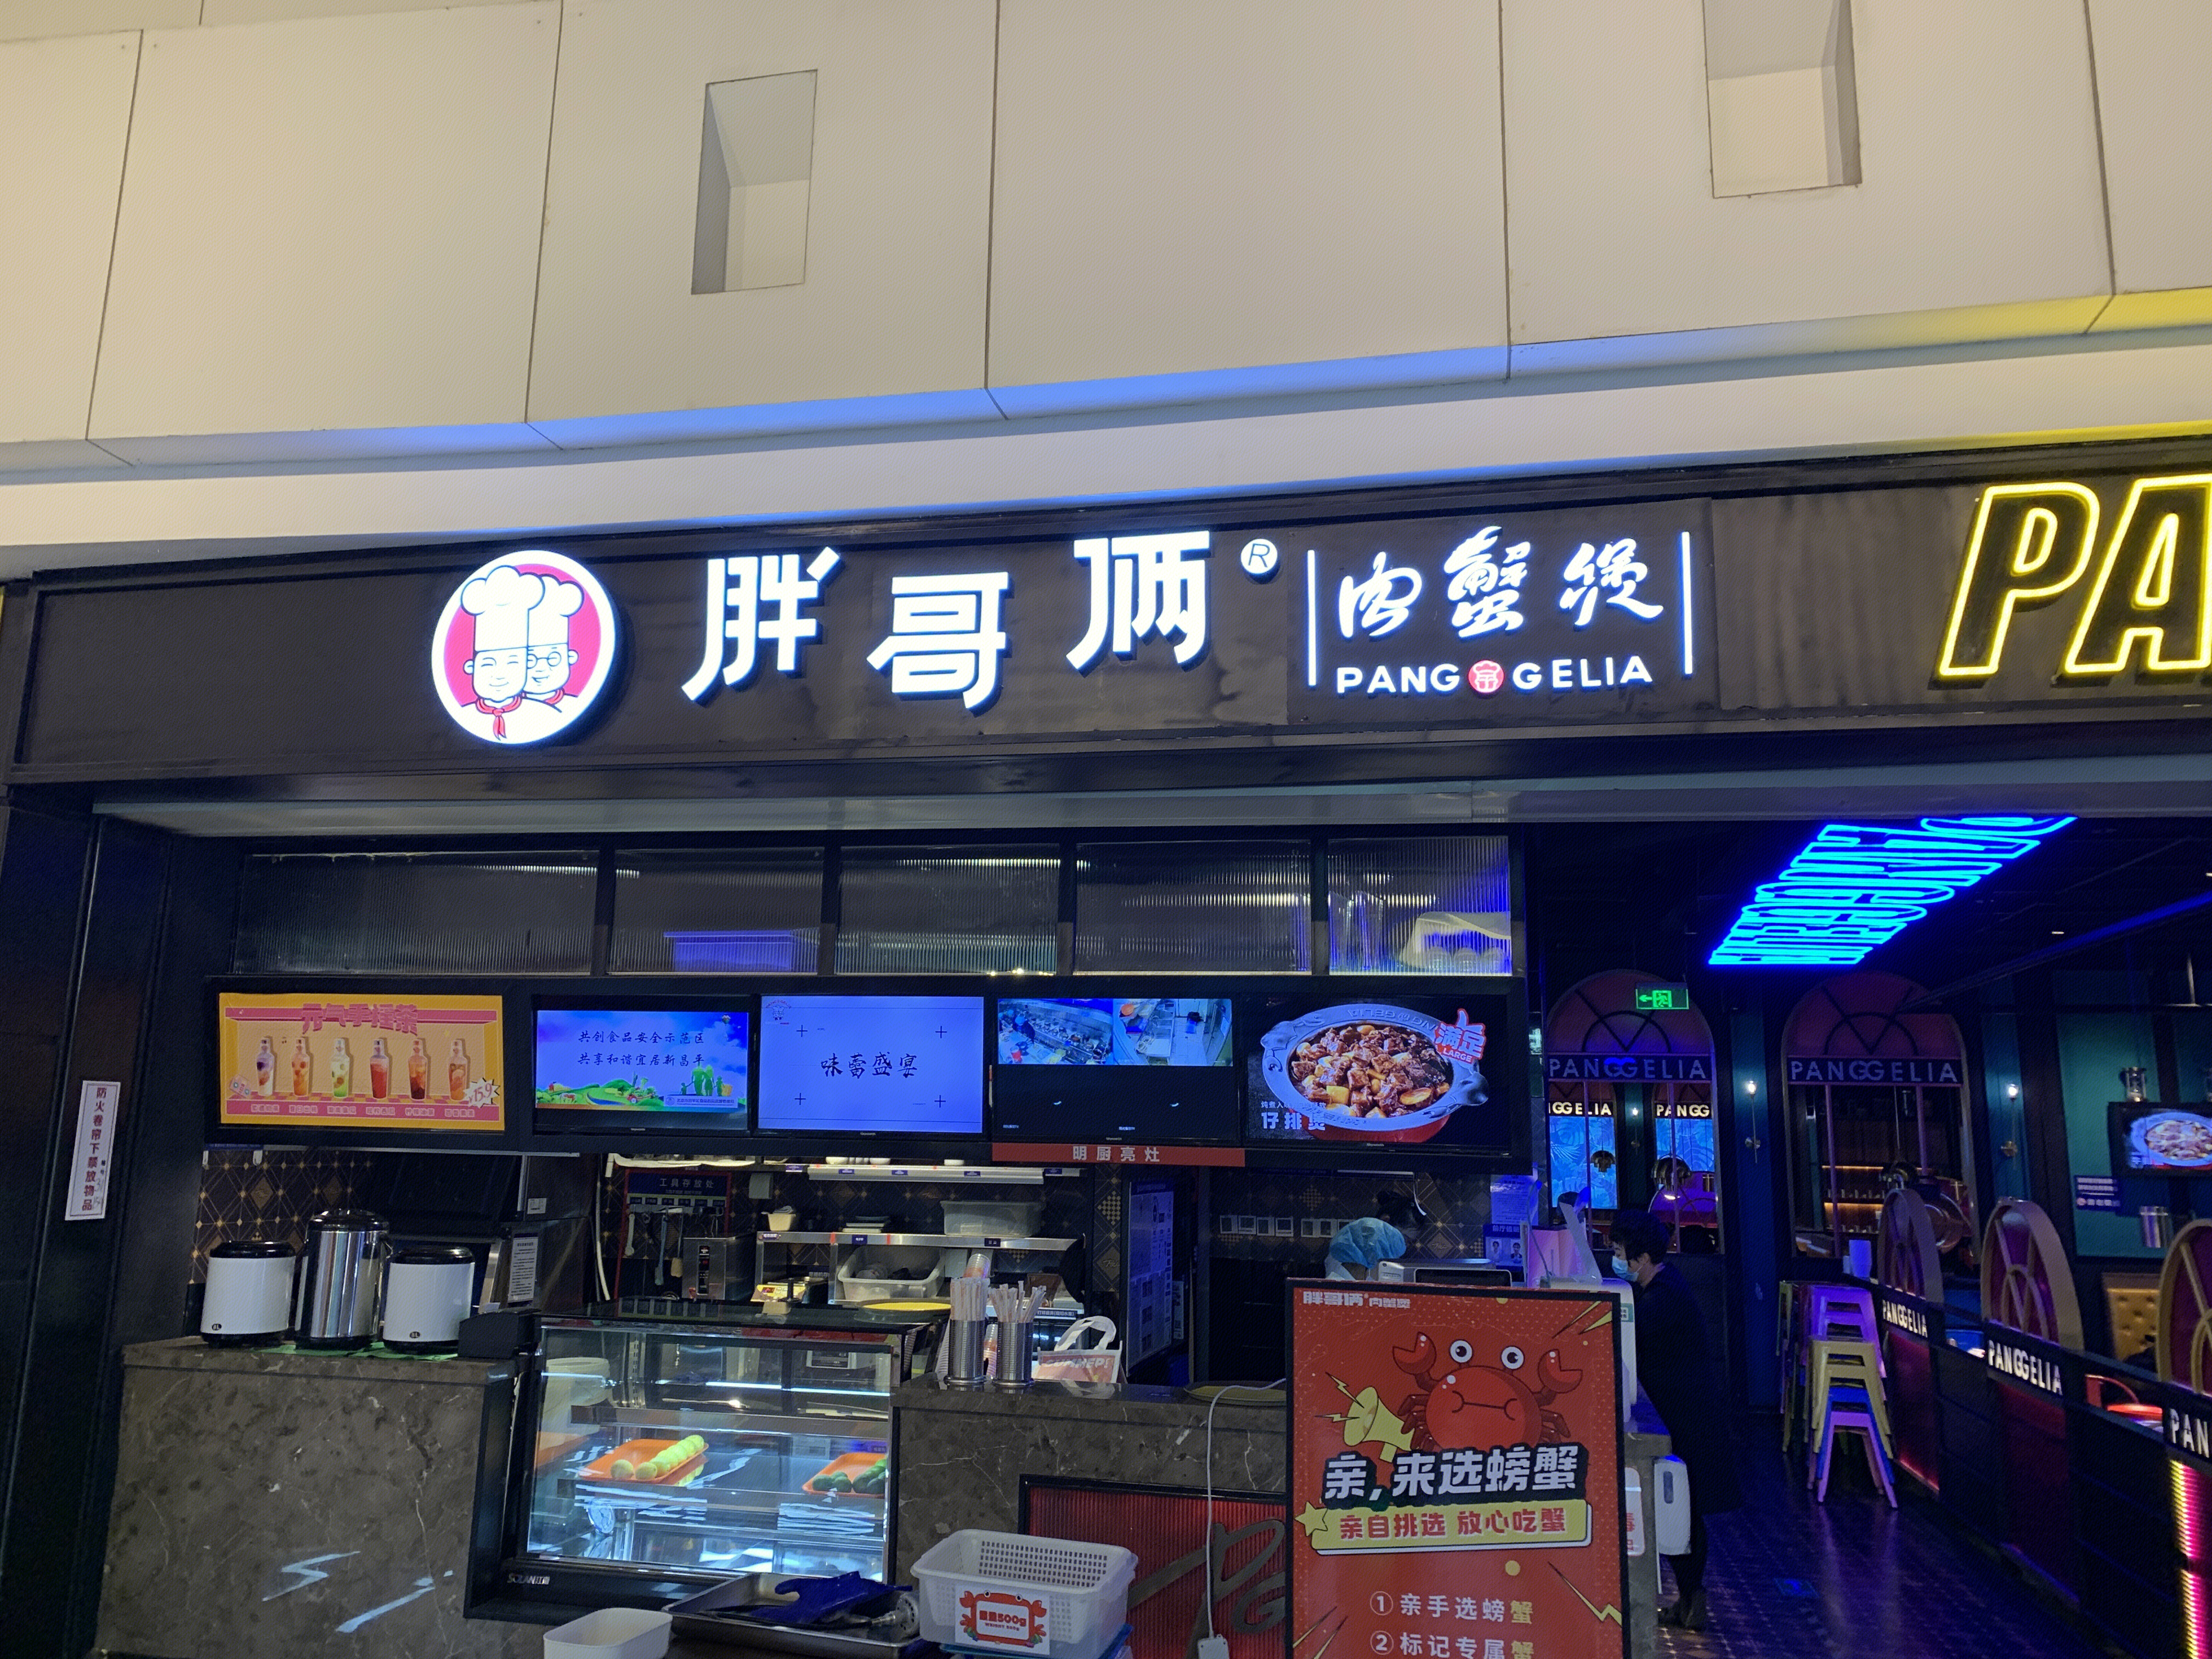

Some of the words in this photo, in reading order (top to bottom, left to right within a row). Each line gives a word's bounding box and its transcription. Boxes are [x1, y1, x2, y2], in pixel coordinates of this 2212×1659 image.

[1338, 526, 1664, 638] 肉蟹煲
[681, 530, 1210, 709] 胖哥俩
[1337, 663, 1460, 693] PANG
[1513, 656, 1653, 689] GELIA
[578, 1030, 705, 1044] 共创食品安全示范区
[1435, 1022, 1485, 1058] 满足
[577, 1052, 706, 1066] 共享和谐宜居新昌平
[821, 1051, 918, 1079] 味蕾盛宴
[1442, 1047, 1473, 1063] LARGE
[1549, 1058, 1707, 1079] PANGGELIA
[1791, 1060, 1959, 1083] PANGGELIA
[1073, 1145, 1161, 1163] 明厨亮灶
[659, 1178, 714, 1188] 工具存放处
[1303, 1291, 1364, 1307] 胖哥俩
[1369, 1297, 1411, 1309] 肉蟹煲
[1883, 1299, 1928, 1338] PANGGELIA
[1987, 1339, 2063, 1396] PANGGELIA
[2170, 1408, 2210, 1458] PAN
[1325, 1445, 1579, 1502] 亲,来选螃蟹
[1340, 1514, 1447, 1540] 亲自挑选
[1457, 1507, 1567, 1534] 放心吃蟹
[1400, 1593, 1534, 1625] 亲手选螃蟹
[1400, 1632, 1534, 1659] 标记专属蟹
